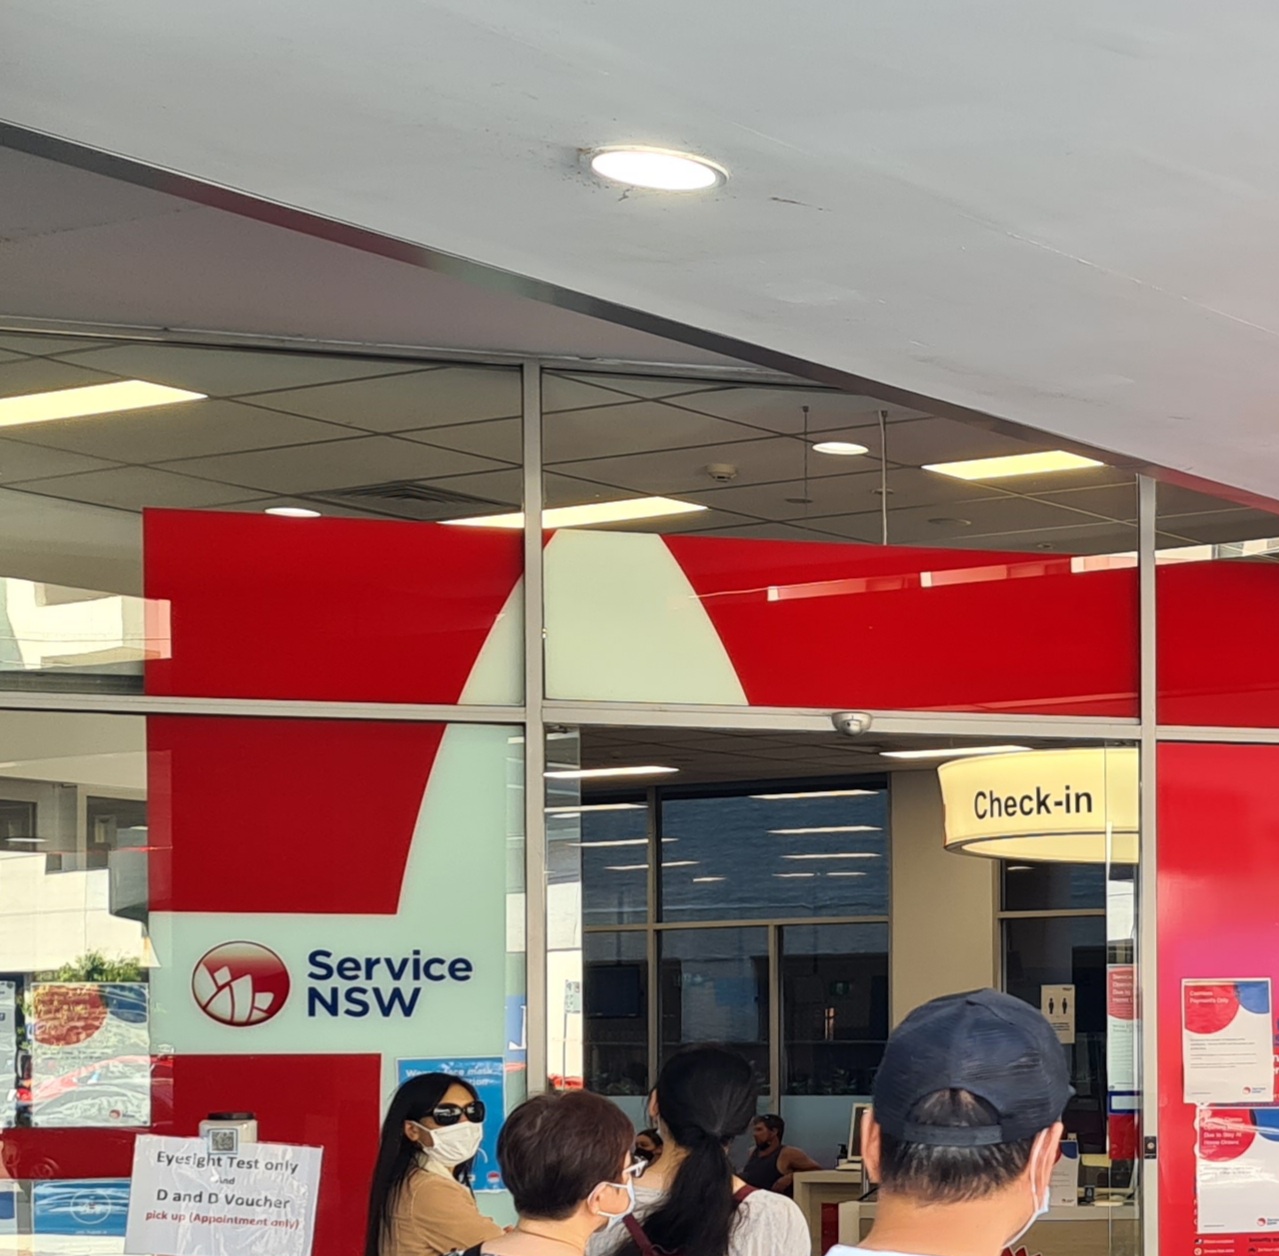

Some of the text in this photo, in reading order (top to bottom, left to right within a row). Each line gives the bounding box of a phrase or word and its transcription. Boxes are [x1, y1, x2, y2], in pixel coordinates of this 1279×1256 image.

[974, 785, 1093, 820] Check-in
[307, 949, 474, 982] Service
[307, 986, 422, 1017] NSW
[157, 1151, 299, 1174] Eyesight Test only
[157, 1188, 291, 1209] D and D Voucher
[145, 1211, 300, 1231] pick up (Appointment only)
